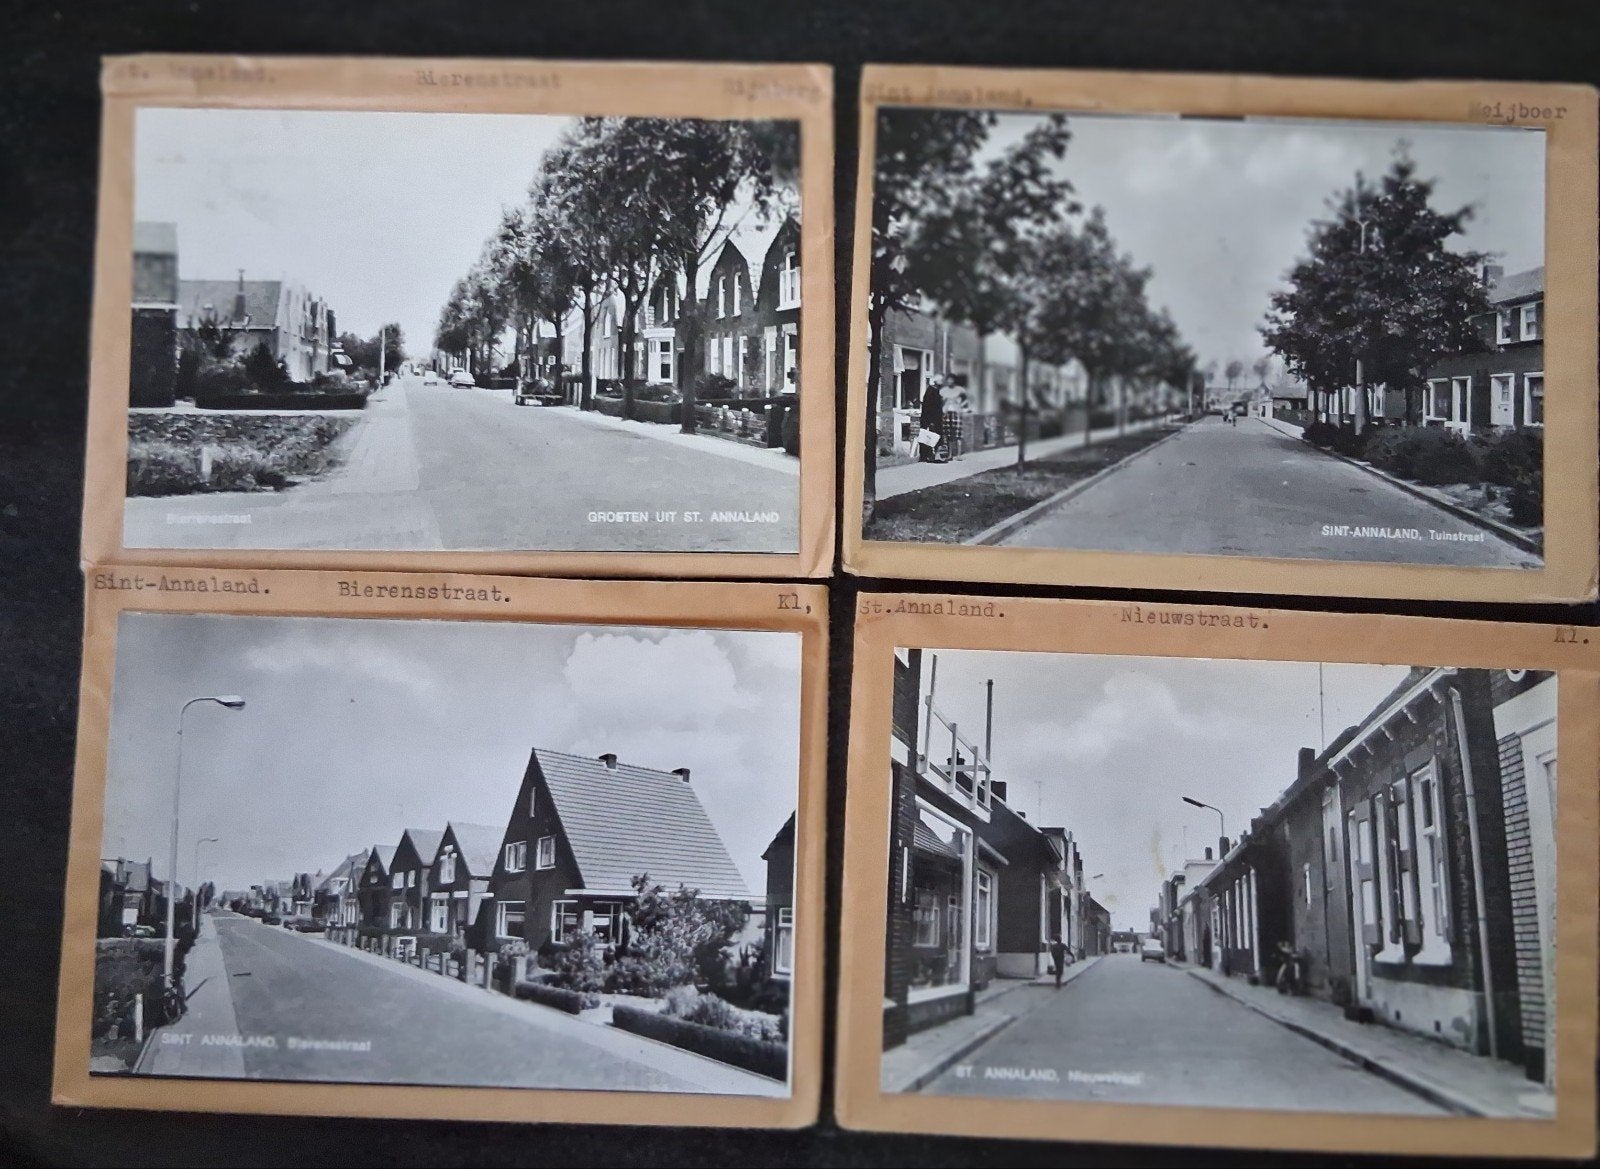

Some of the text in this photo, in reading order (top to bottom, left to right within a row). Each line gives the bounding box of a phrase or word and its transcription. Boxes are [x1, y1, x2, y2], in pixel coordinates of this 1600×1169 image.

[588, 511, 780, 523] GROETEN UIT ST. ANNALAND
[1321, 525, 1484, 542] SINT-ANNALAND, Tuinstraat
[93, 574, 271, 595] Sint-Annaland.
[338, 581, 512, 603] Bierensstraat.
[1121, 608, 1270, 630] Nieuwstraat.
[161, 1032, 193, 1045] SINT
